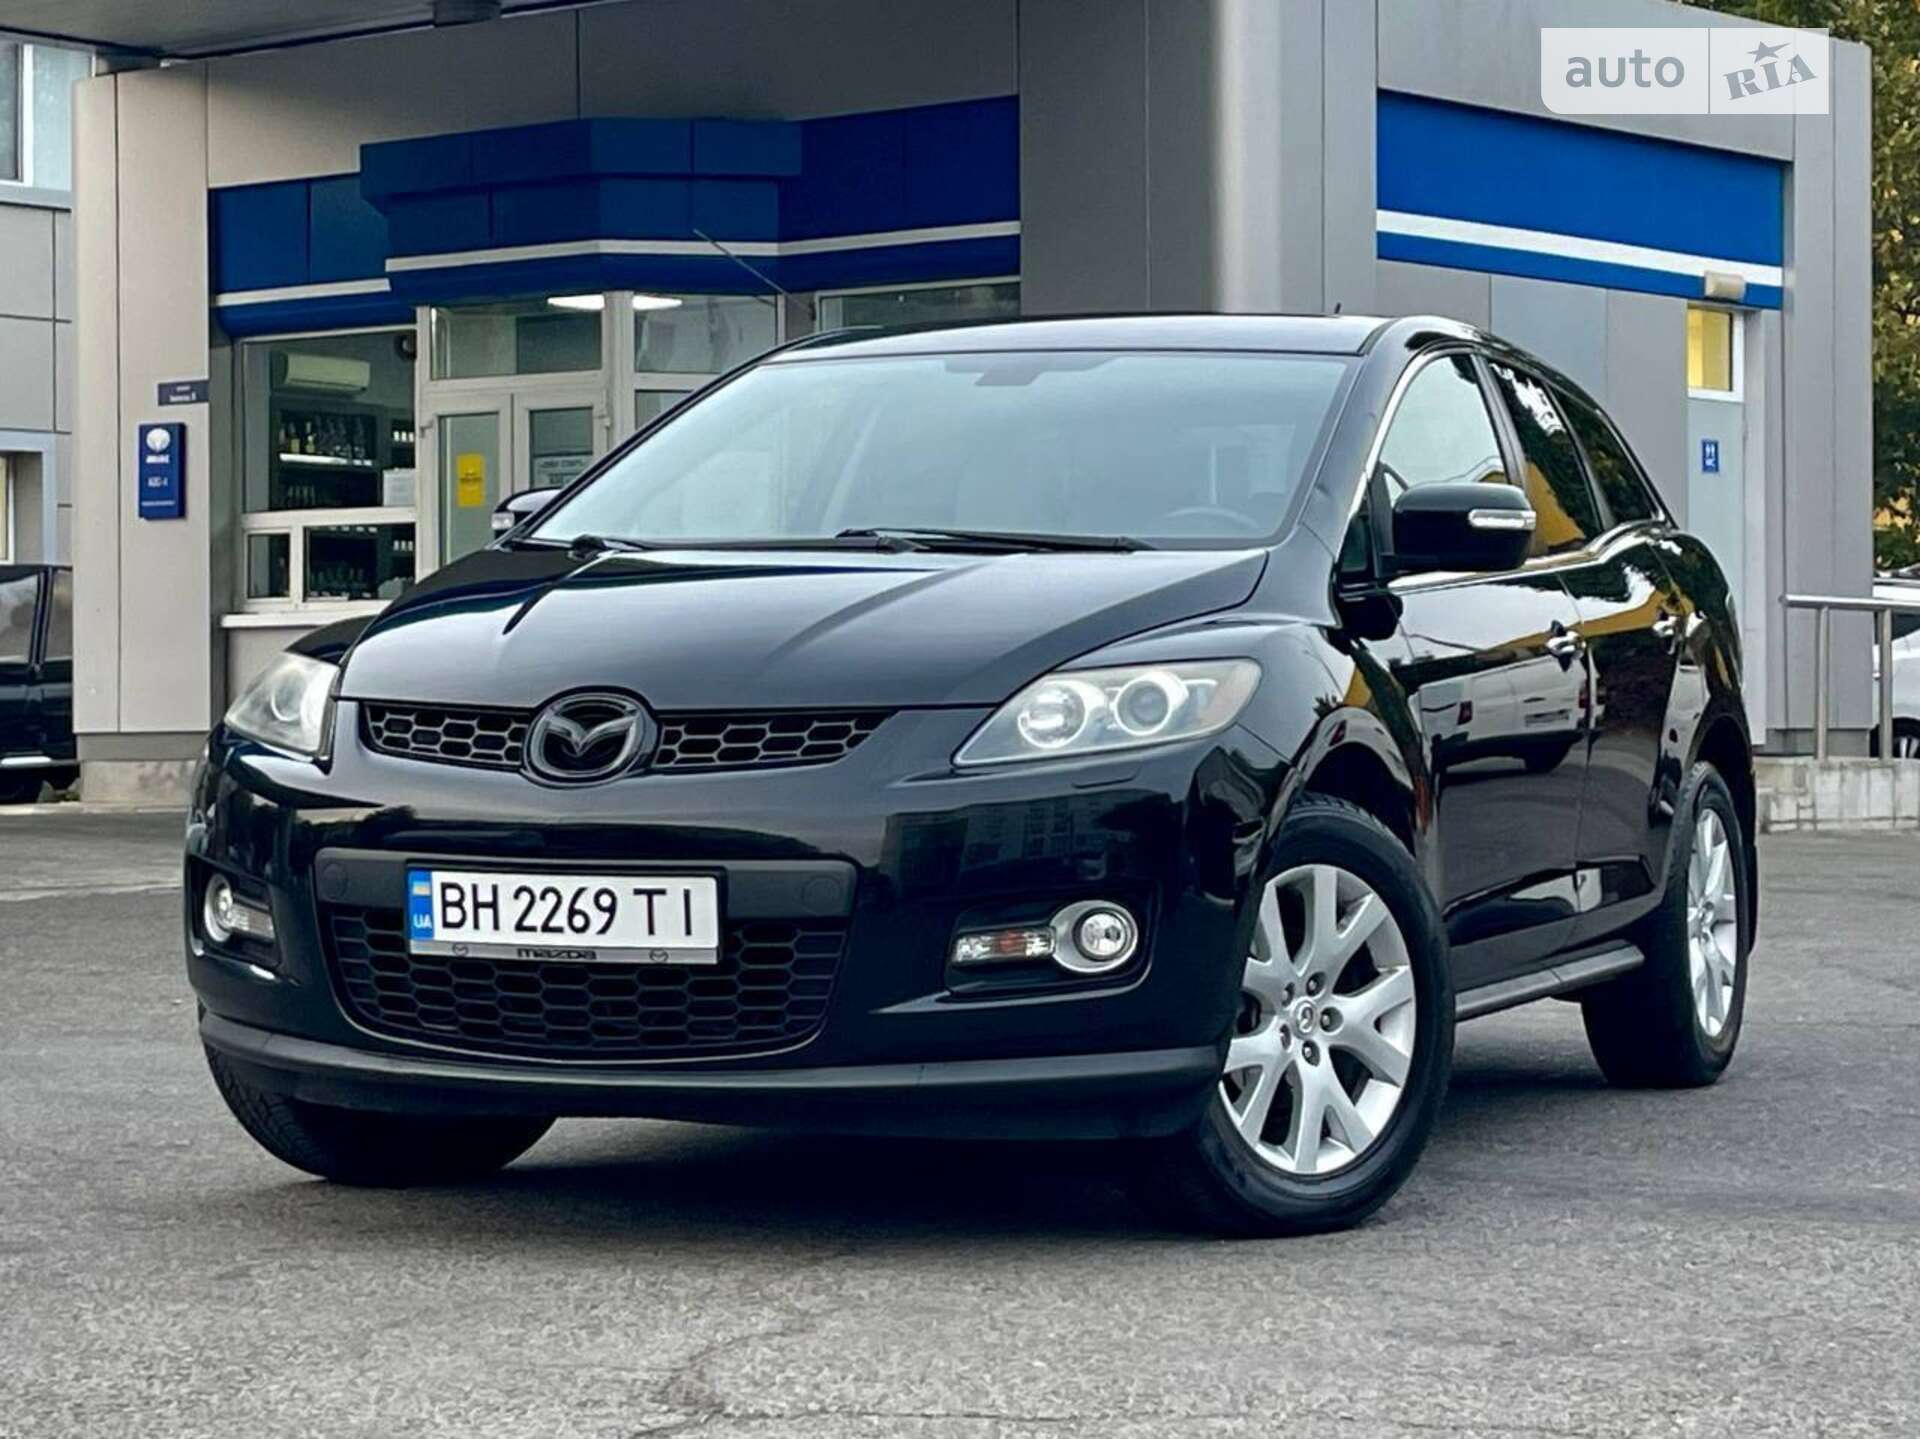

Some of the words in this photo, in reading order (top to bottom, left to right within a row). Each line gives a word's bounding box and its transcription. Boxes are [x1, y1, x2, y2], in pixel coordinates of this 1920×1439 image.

[413, 914, 432, 929] UA
[440, 881, 500, 931] BH
[513, 885, 618, 935] 2269
